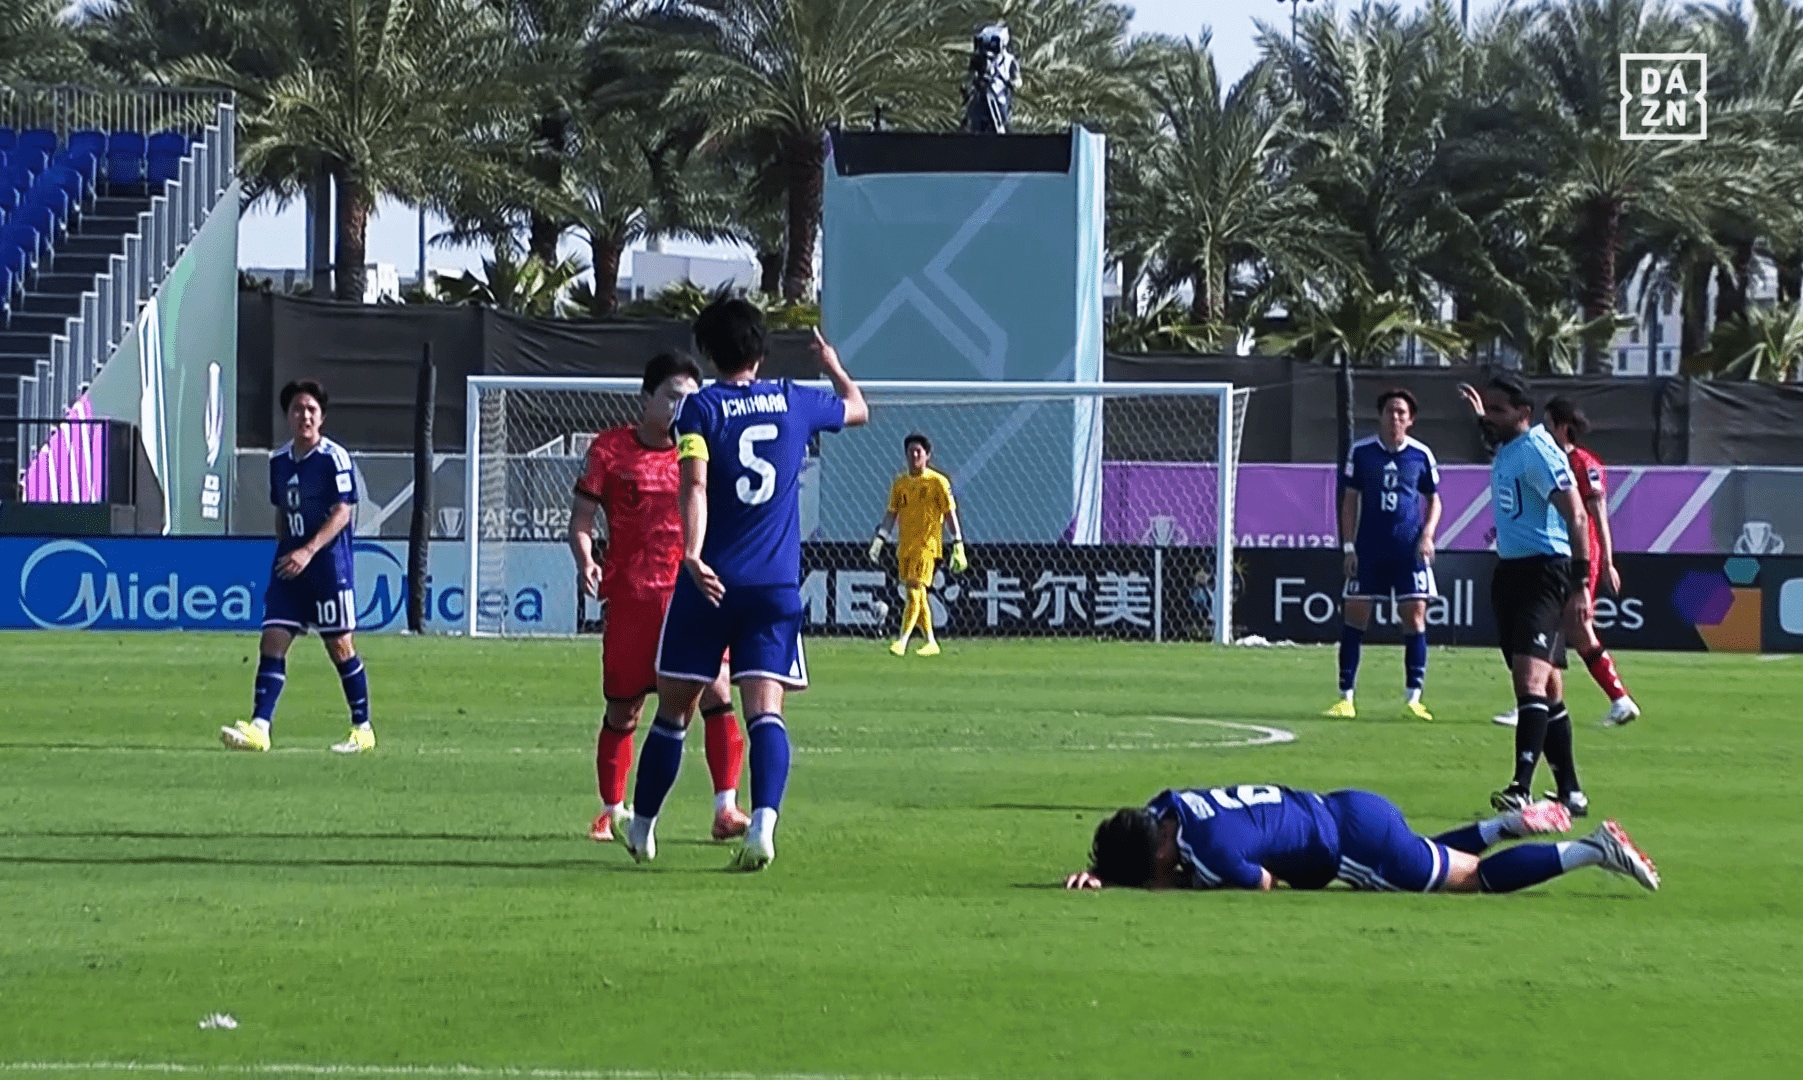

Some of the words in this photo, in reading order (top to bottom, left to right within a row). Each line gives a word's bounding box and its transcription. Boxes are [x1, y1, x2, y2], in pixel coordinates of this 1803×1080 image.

[735, 424, 778, 505] 5
[1380, 491, 1399, 512] 19
[287, 512, 305, 537] 10
[1411, 569, 1428, 592] 19
[56, 571, 252, 621] Midea
[968, 569, 1151, 627] 卡尔美
[316, 599, 337, 625] 10
